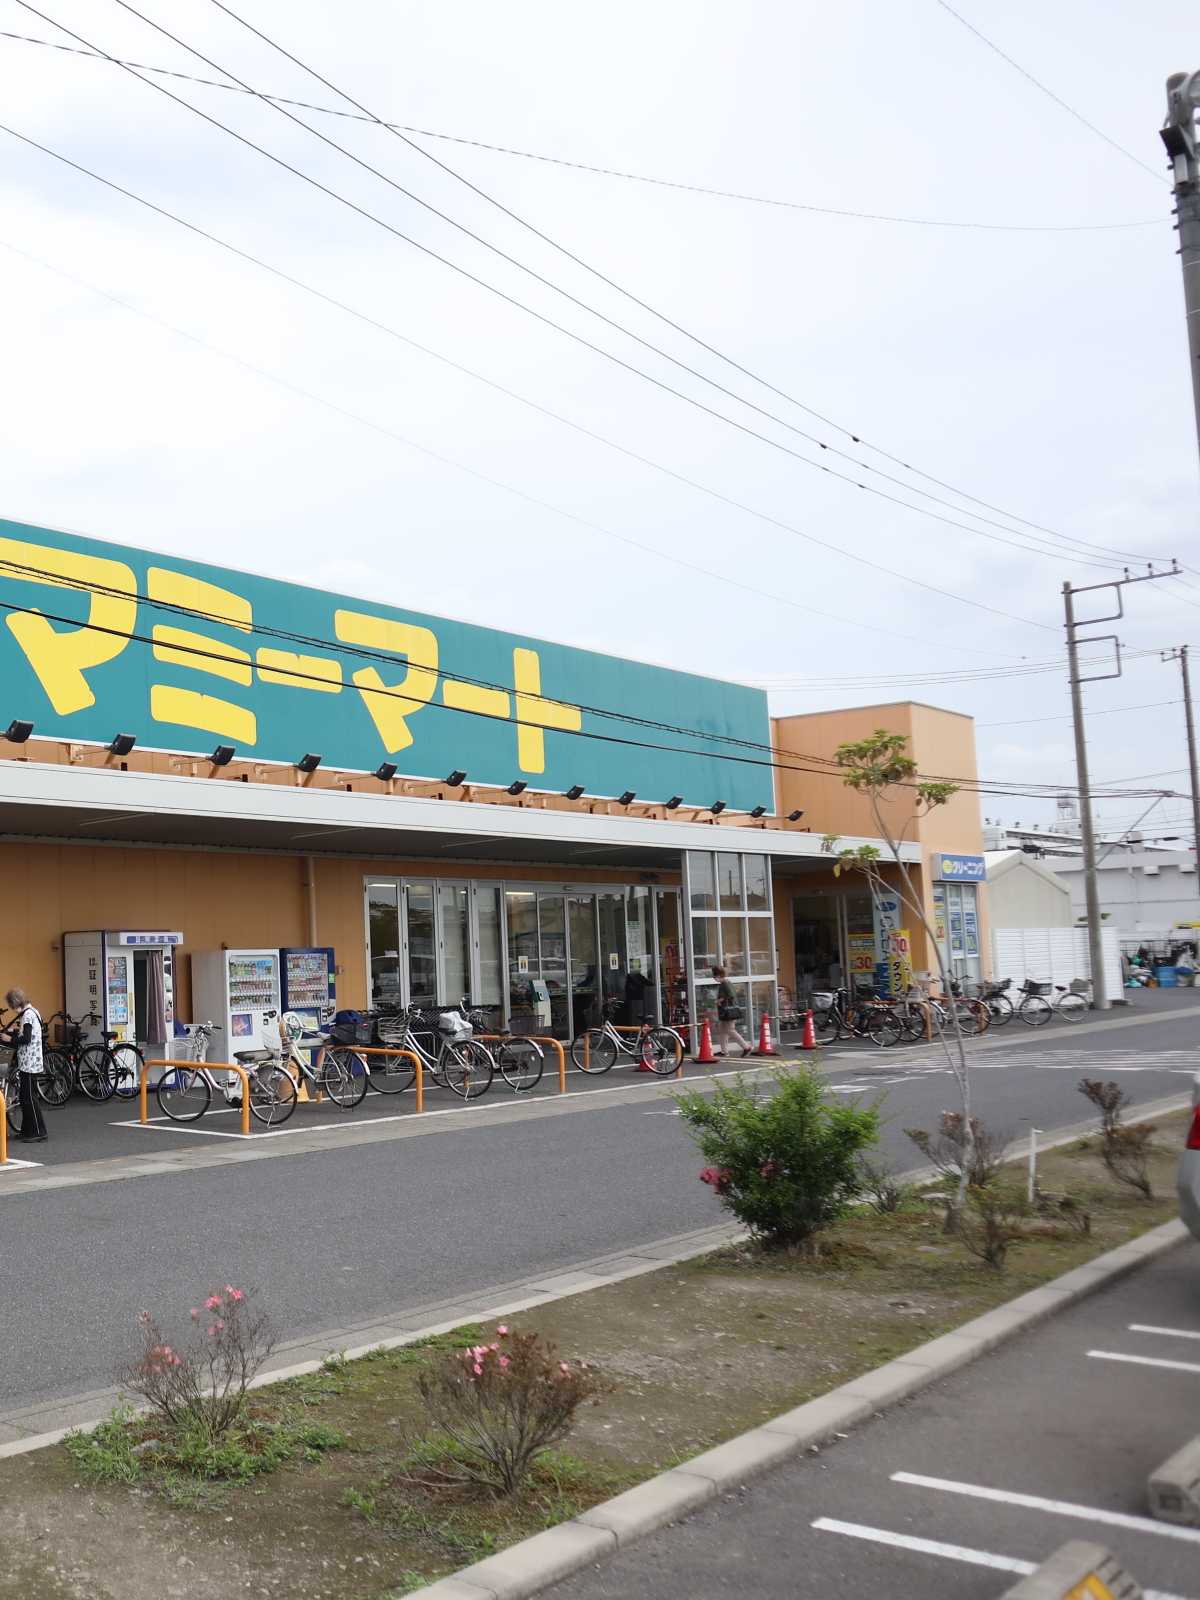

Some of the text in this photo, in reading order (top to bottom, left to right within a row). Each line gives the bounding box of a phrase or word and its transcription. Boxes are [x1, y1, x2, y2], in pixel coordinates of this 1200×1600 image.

[952, 861, 984, 875] クリーニング
[856, 956, 873, 970] 30
[89, 970, 99, 1027] 証明写真
